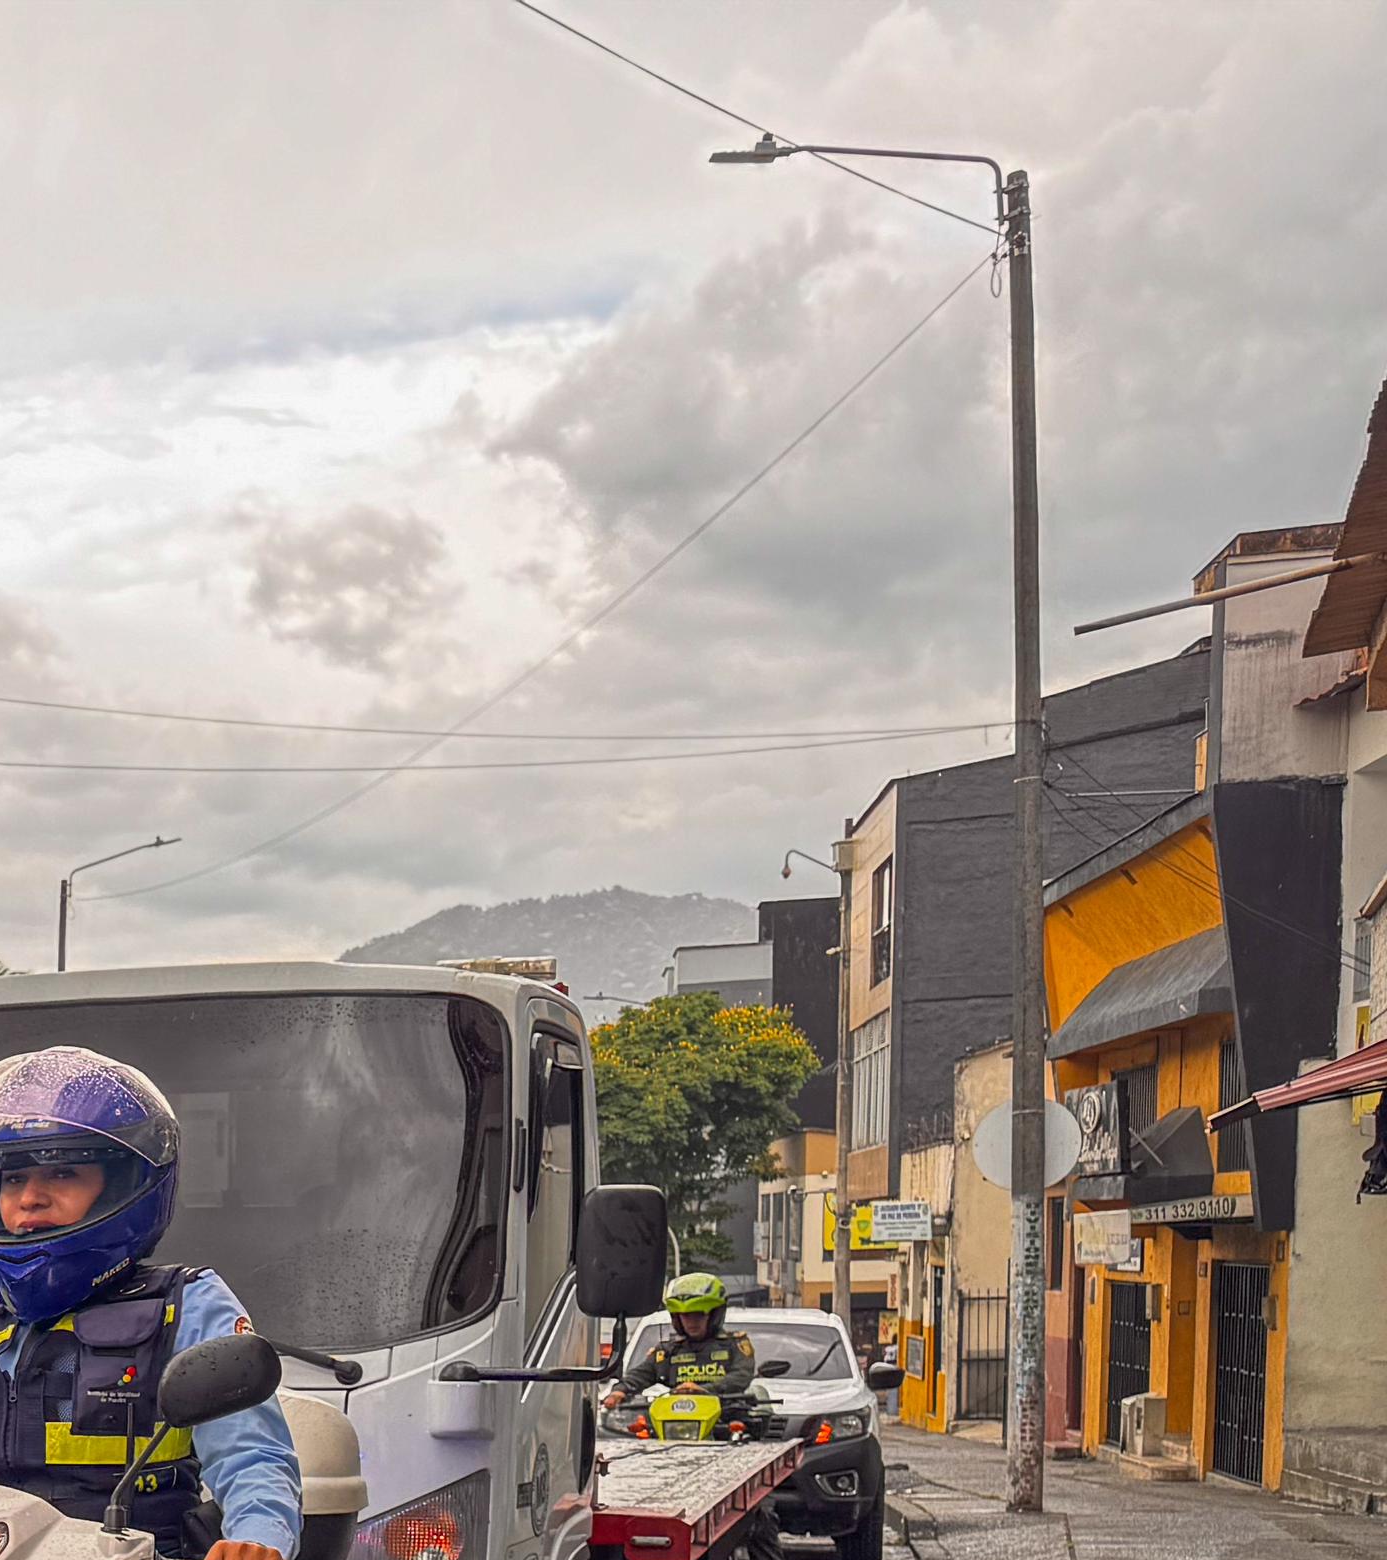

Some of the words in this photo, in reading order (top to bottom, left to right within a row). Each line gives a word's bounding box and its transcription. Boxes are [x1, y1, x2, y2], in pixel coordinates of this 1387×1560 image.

[1145, 1207, 1167, 1220] 311
[1171, 1203, 1195, 1218] 332
[1199, 1197, 1231, 1217] 9110
